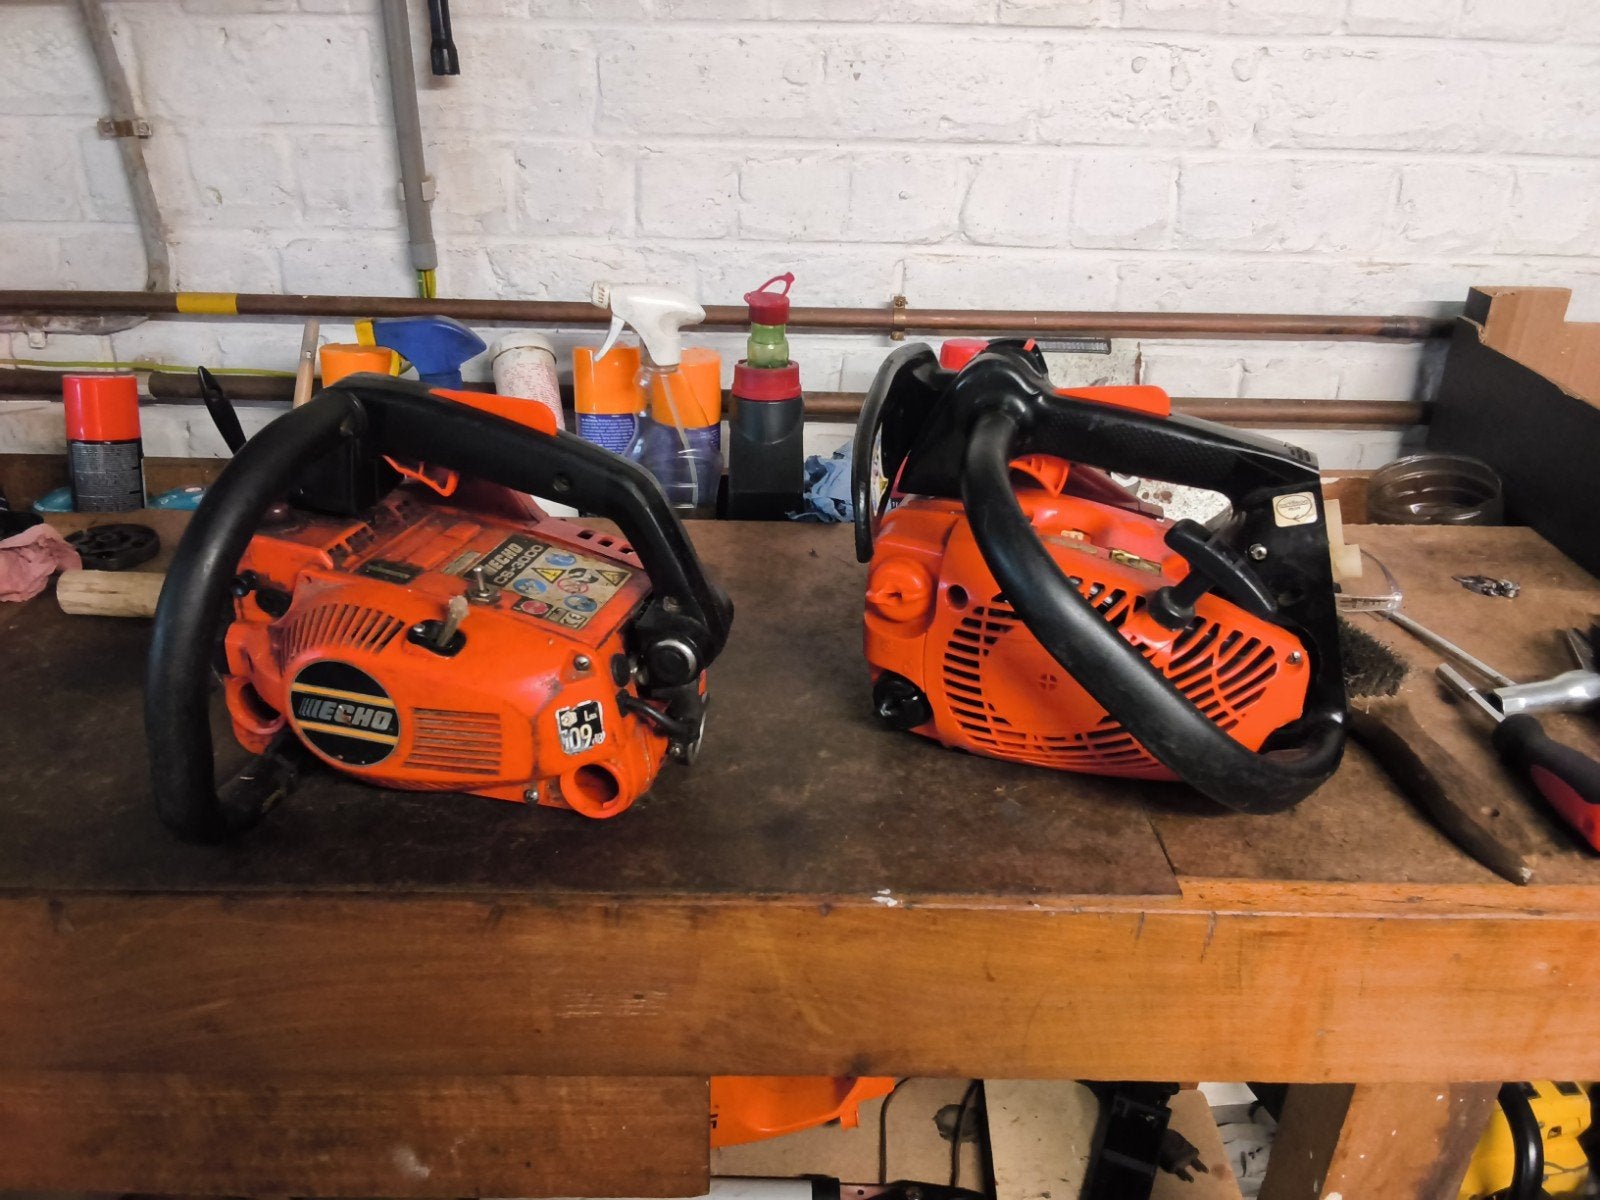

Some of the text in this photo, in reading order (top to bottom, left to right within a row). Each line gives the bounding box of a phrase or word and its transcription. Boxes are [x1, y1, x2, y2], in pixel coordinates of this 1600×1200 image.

[490, 542, 523, 573] ECHO
[494, 544, 544, 585] CS-3000
[318, 700, 393, 731] ECHO
